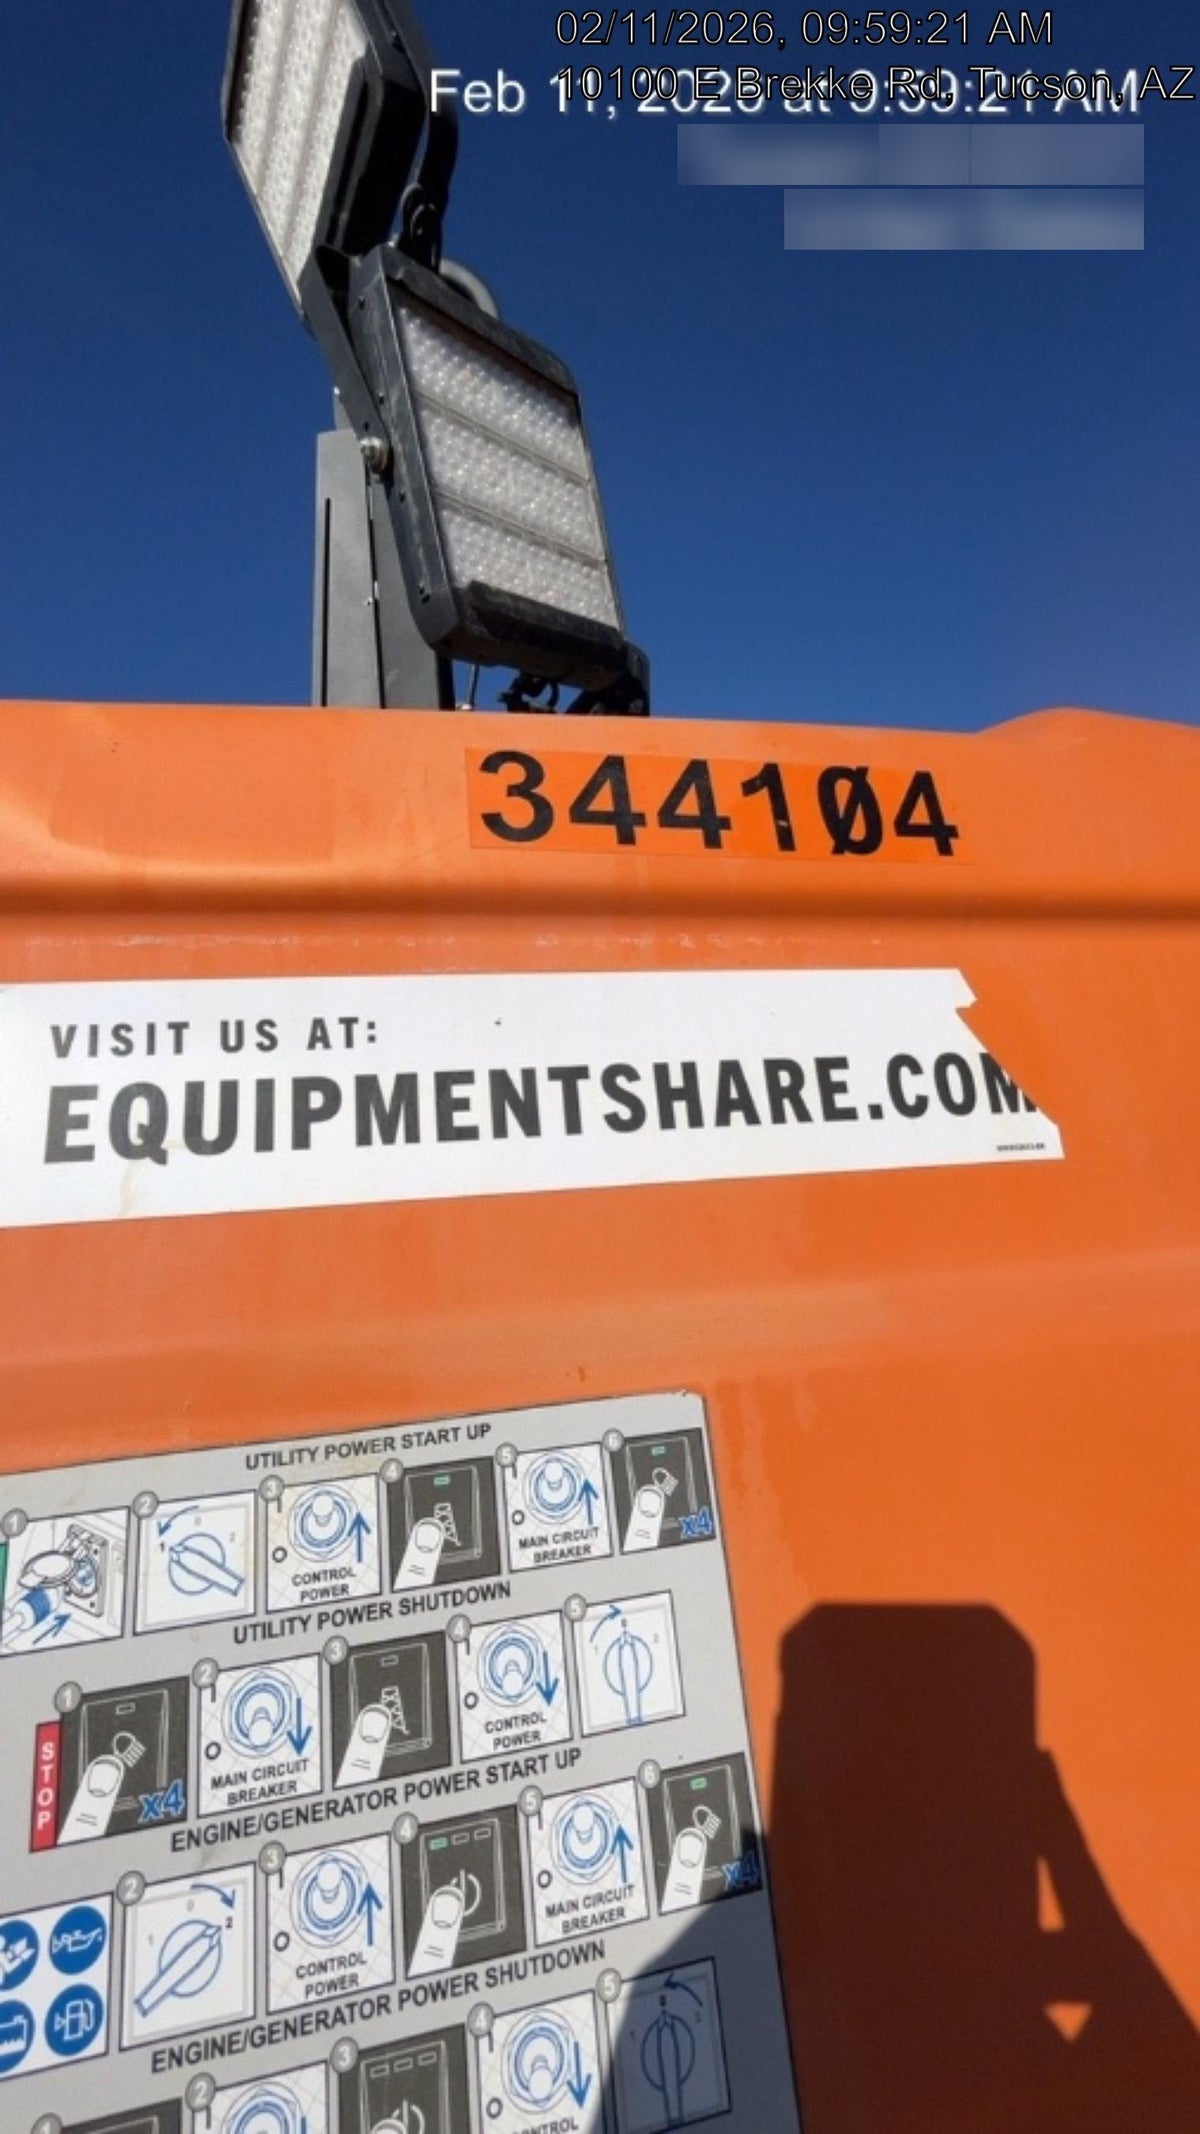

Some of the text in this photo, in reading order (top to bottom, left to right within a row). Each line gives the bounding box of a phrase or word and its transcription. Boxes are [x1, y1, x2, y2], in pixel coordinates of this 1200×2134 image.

[478, 750, 960, 857] 344104
[50, 1016, 378, 1058] VISIT US AT:
[43, 1050, 1038, 1166] EQUIPMENTSHARE.COM
[246, 1422, 492, 1471] UTILITY POWER START UP
[518, 1526, 600, 1550] MAIN CIRCUIT
[533, 1545, 593, 1565] BREAKER
[291, 1566, 357, 1588] CONTROL
[300, 1583, 350, 1603] POWER
[234, 1581, 512, 1645] UTILITY POWER SHUTDOWN
[485, 1710, 547, 1735] CONTROL
[492, 1729, 542, 1751] POWER
[36, 1741, 56, 1830] STOP
[210, 1758, 310, 1791] MAIN CIRCUIT
[170, 1746, 583, 1854] ENGINE/GENERATOR POWER START UP
[226, 1780, 298, 1807] BREAKER
[545, 1884, 635, 1919] MAIN CIRCUIT
[561, 1906, 627, 1934] BREAKER
[296, 1951, 368, 1980] CONTROL
[304, 1972, 360, 1999] POWER
[151, 1938, 607, 2074] ENGINE/GENERATOR POWER SHUTDOWN
[512, 2116, 579, 2134] ONTROL
